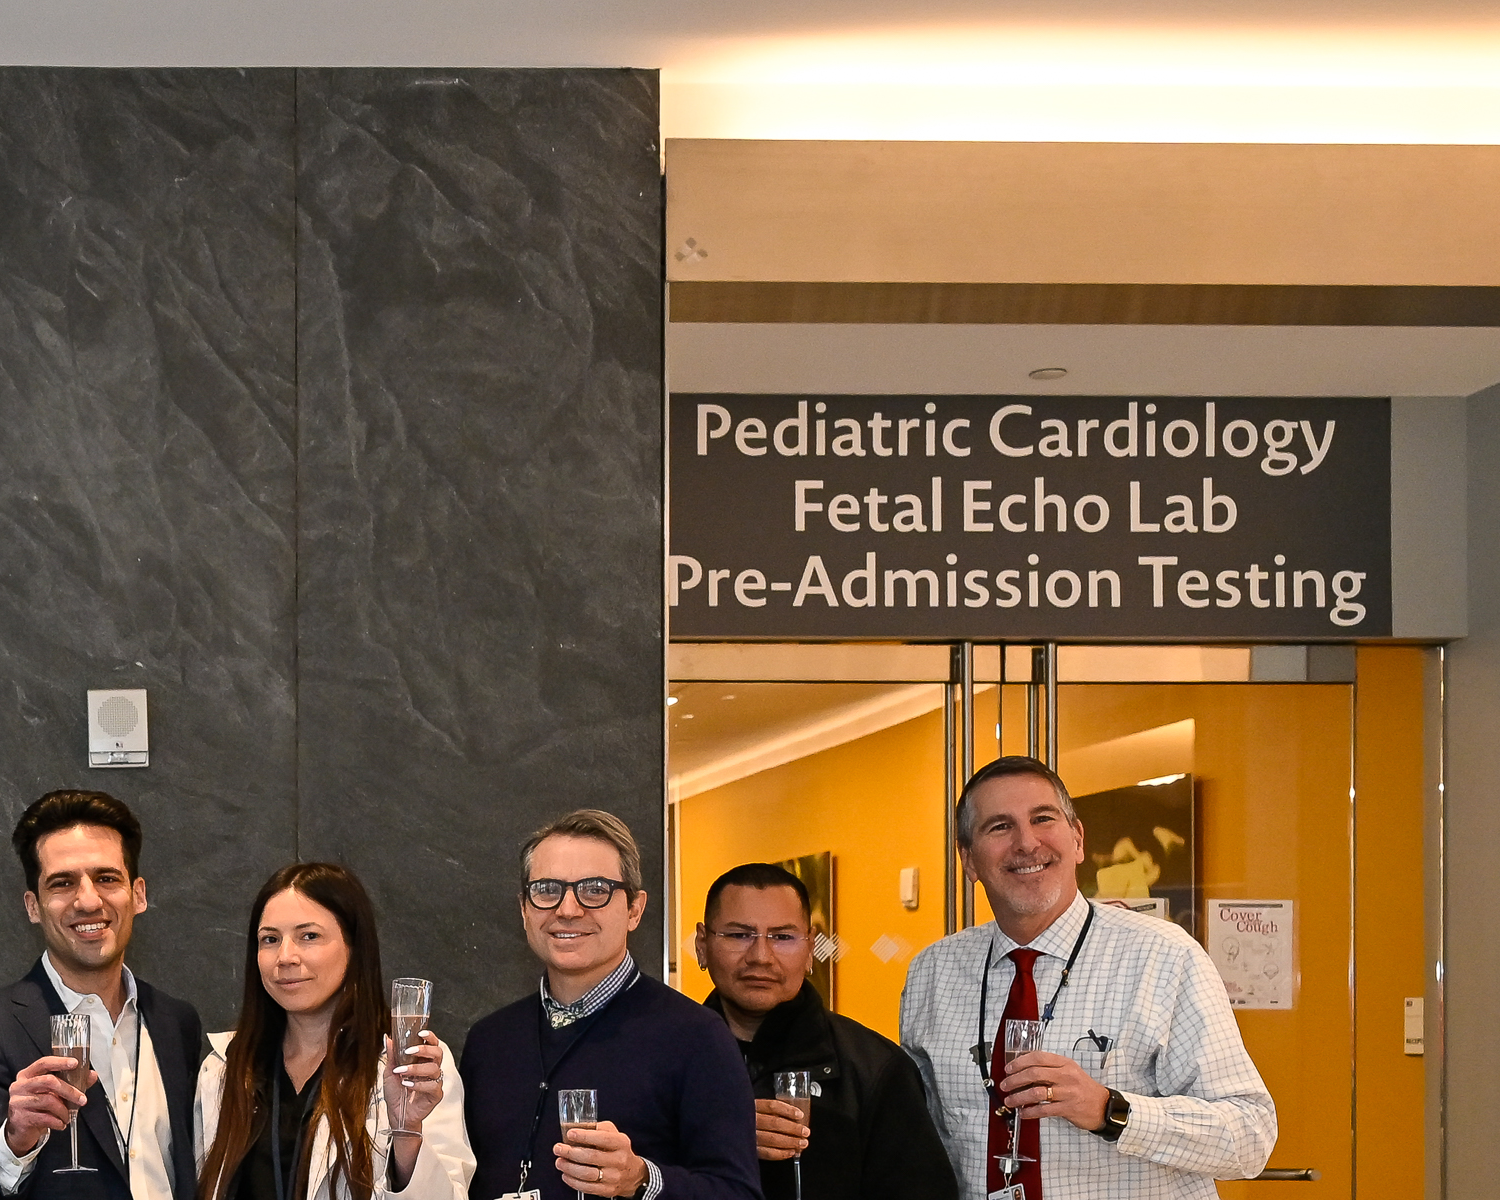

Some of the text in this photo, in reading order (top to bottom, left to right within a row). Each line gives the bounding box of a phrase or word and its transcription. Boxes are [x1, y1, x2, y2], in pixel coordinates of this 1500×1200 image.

[696, 401, 1336, 476] Pediatric Cardiology
[794, 477, 1238, 533] Fetal Echo Lab
[669, 552, 1367, 626] Pre-Admission Testing
[1220, 908, 1262, 922] Cover
[1236, 921, 1278, 936] Cough
